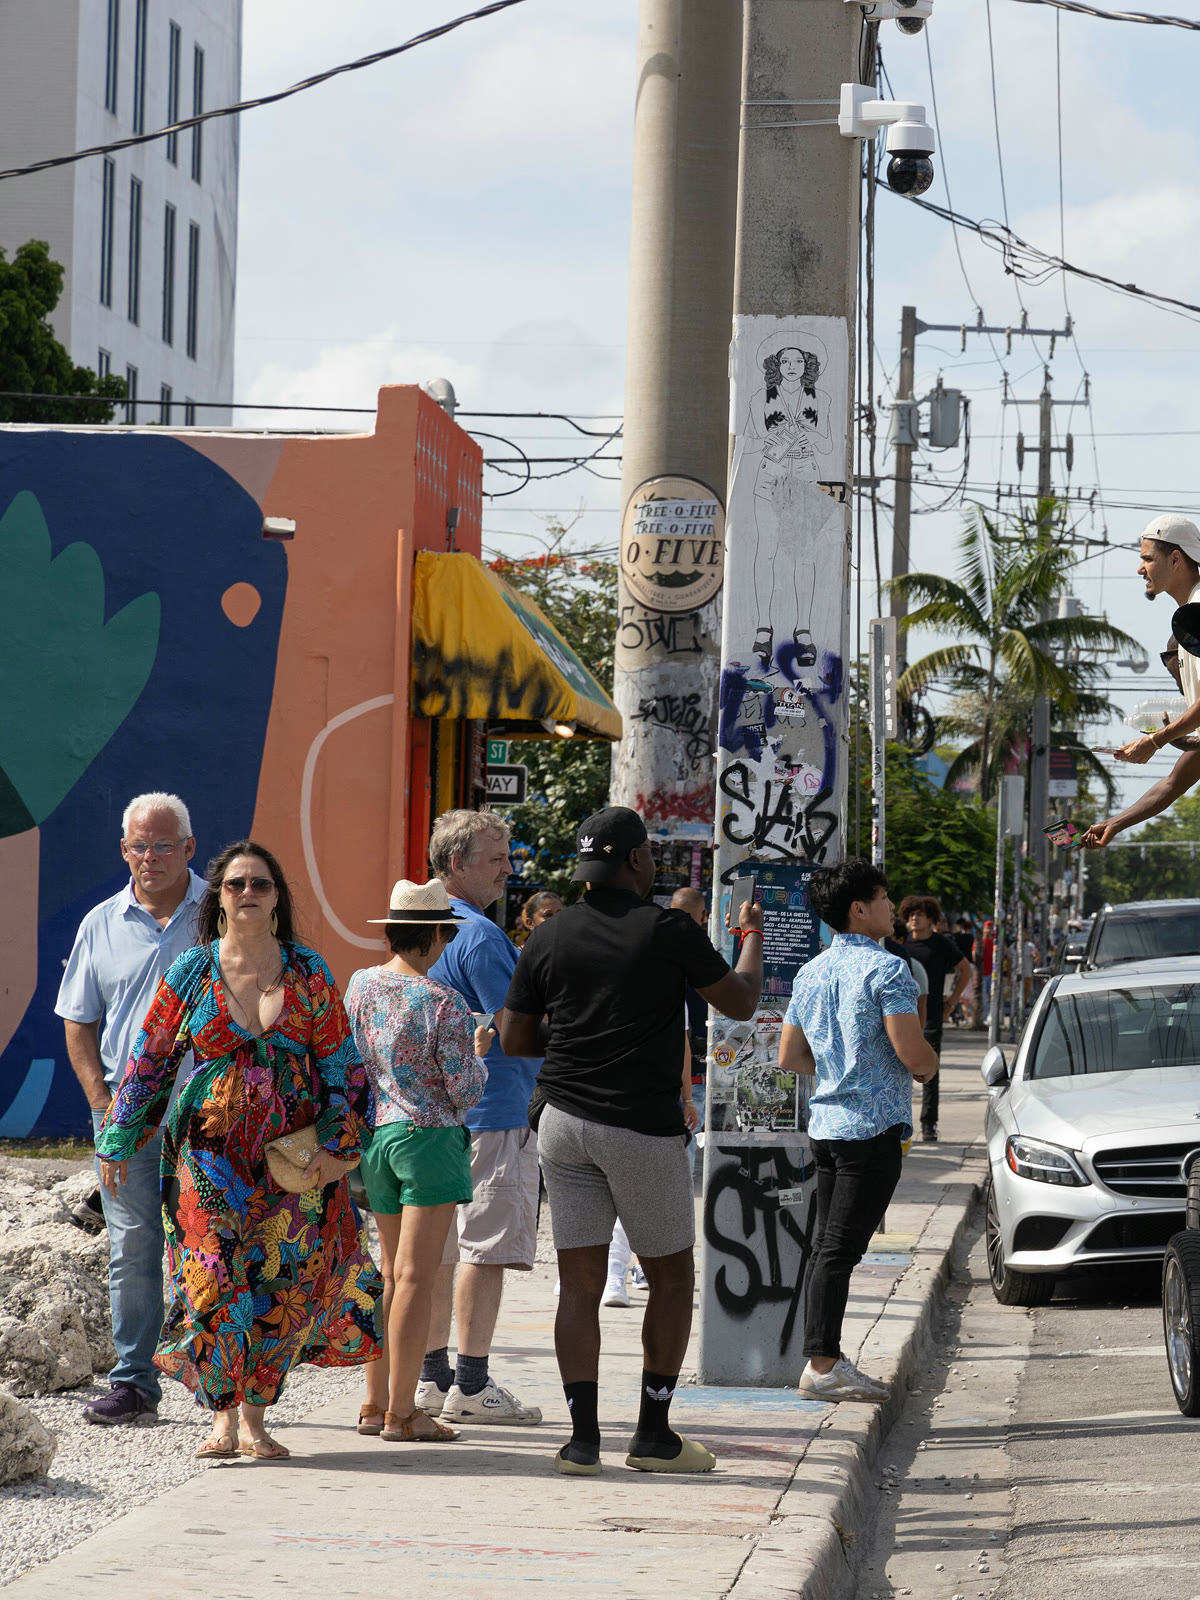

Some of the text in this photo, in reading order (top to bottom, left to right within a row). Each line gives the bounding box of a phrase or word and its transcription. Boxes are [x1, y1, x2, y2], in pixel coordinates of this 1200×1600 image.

[690, 504, 718, 516] FIVE
[684, 524, 714, 535] FIVE
[652, 539, 721, 564] FIVE
[491, 743, 505, 759] ST
